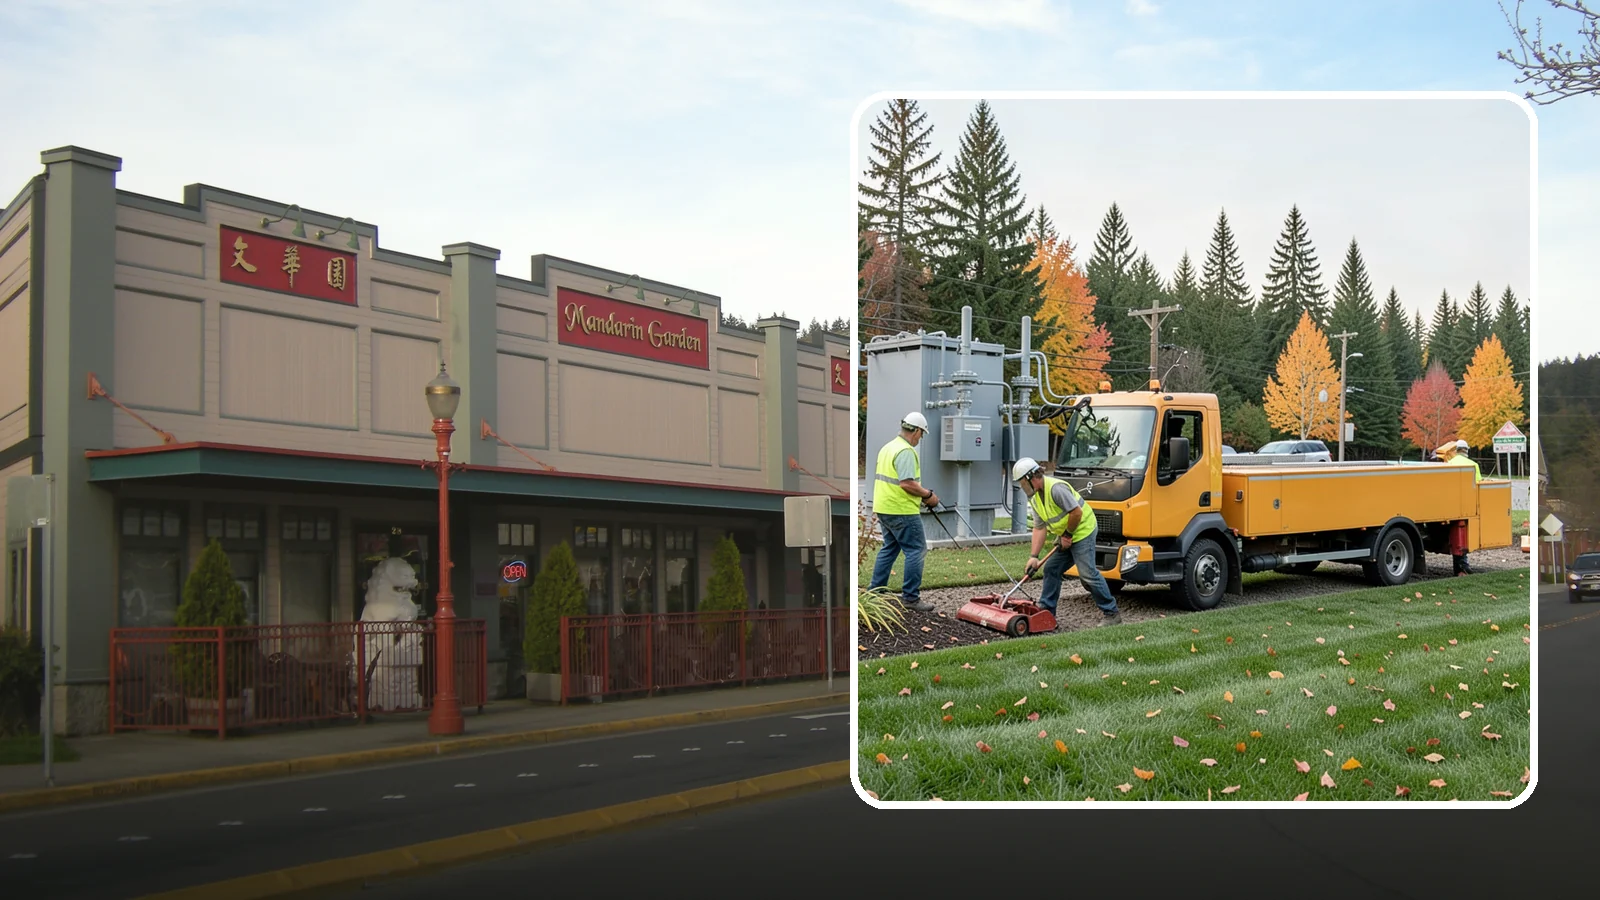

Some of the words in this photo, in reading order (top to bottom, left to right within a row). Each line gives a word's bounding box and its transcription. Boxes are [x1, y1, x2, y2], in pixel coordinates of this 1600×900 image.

[230, 235, 346, 291] 文華園
[564, 302, 644, 340] Mandarin
[647, 320, 702, 352] Garden
[503, 565, 527, 578] OPEN
